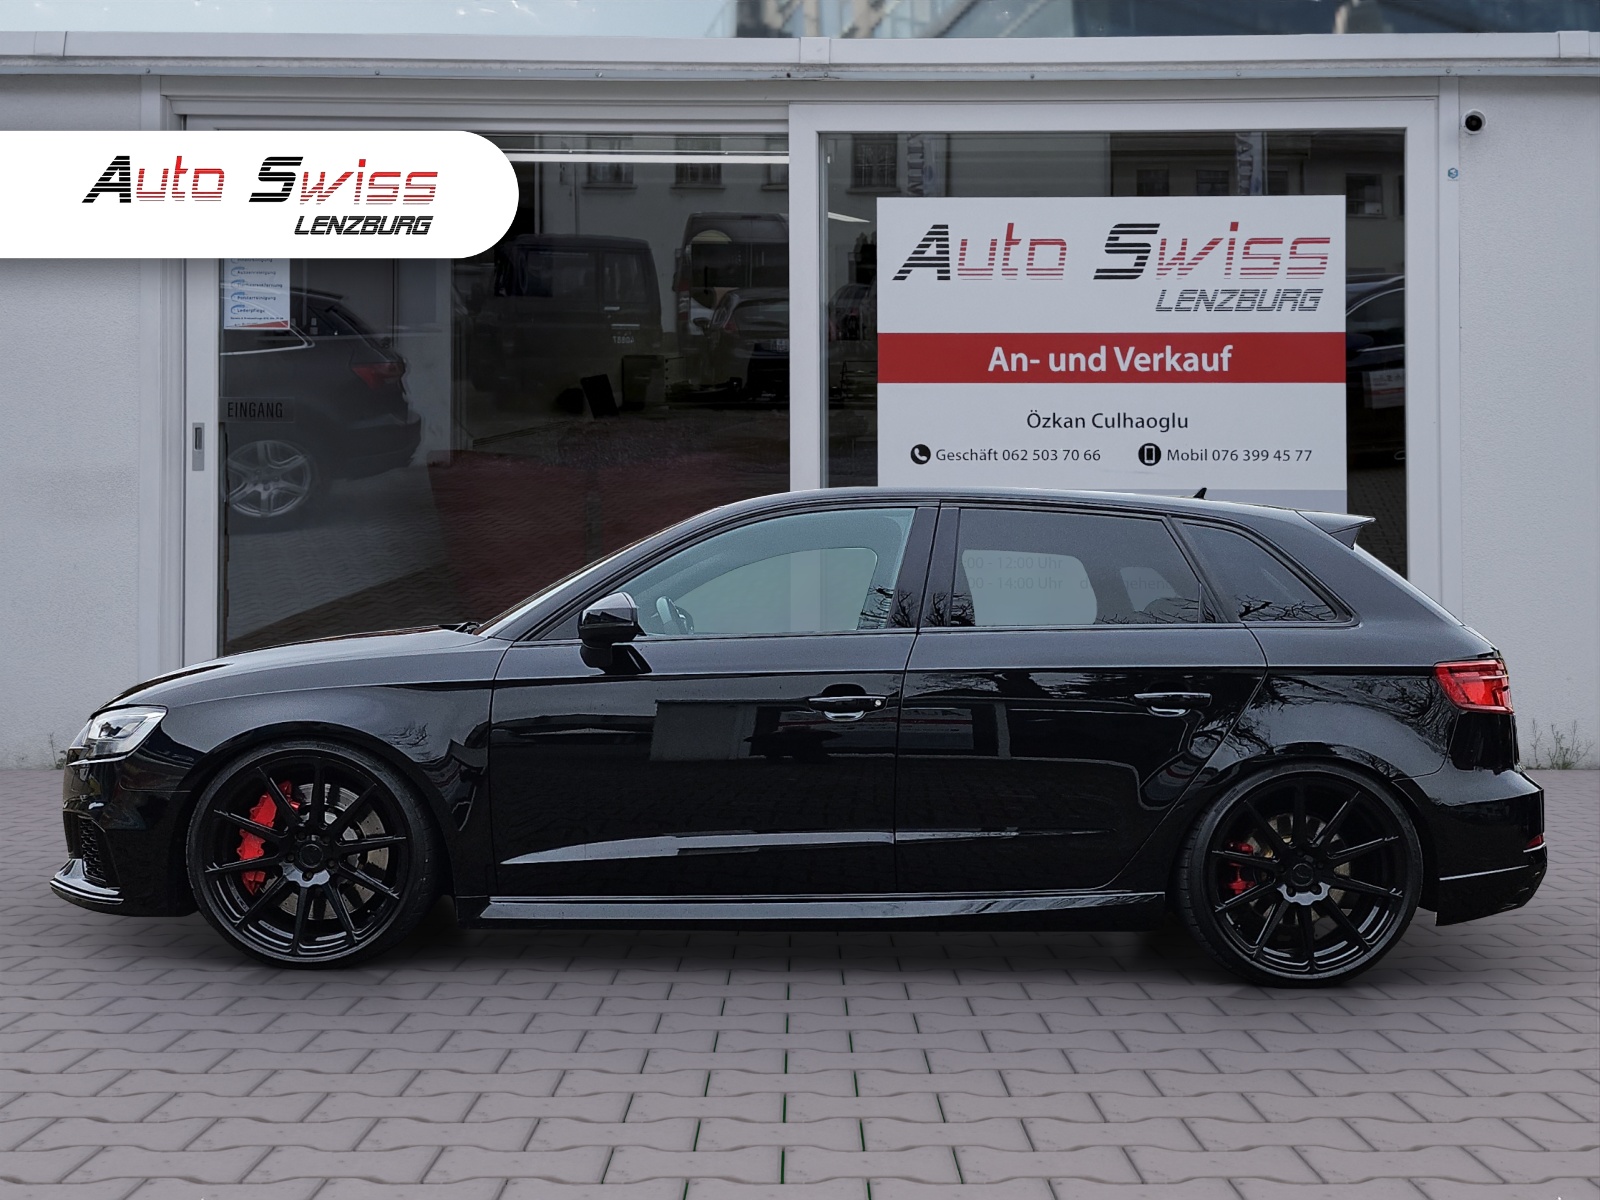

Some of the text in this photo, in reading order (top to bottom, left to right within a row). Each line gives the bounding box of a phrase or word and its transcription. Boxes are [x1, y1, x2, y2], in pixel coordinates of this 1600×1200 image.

[892, 221, 1331, 281] Auto Swiss
[1155, 288, 1325, 312] LENZBURG
[987, 345, 1234, 373] An- und Verkauf
[226, 401, 284, 419] EINGANG
[1026, 410, 1189, 432] Özkan Culhaoglu
[935, 447, 1101, 463] Geschäft 062 503 70 66
[1167, 447, 1313, 462] Mobil 076 399 45 77
[997, 556, 1033, 569] 12:00
[1038, 556, 1062, 569] Uhr
[997, 577, 1033, 589] 14:00
[1038, 576, 1062, 589] Uhr
